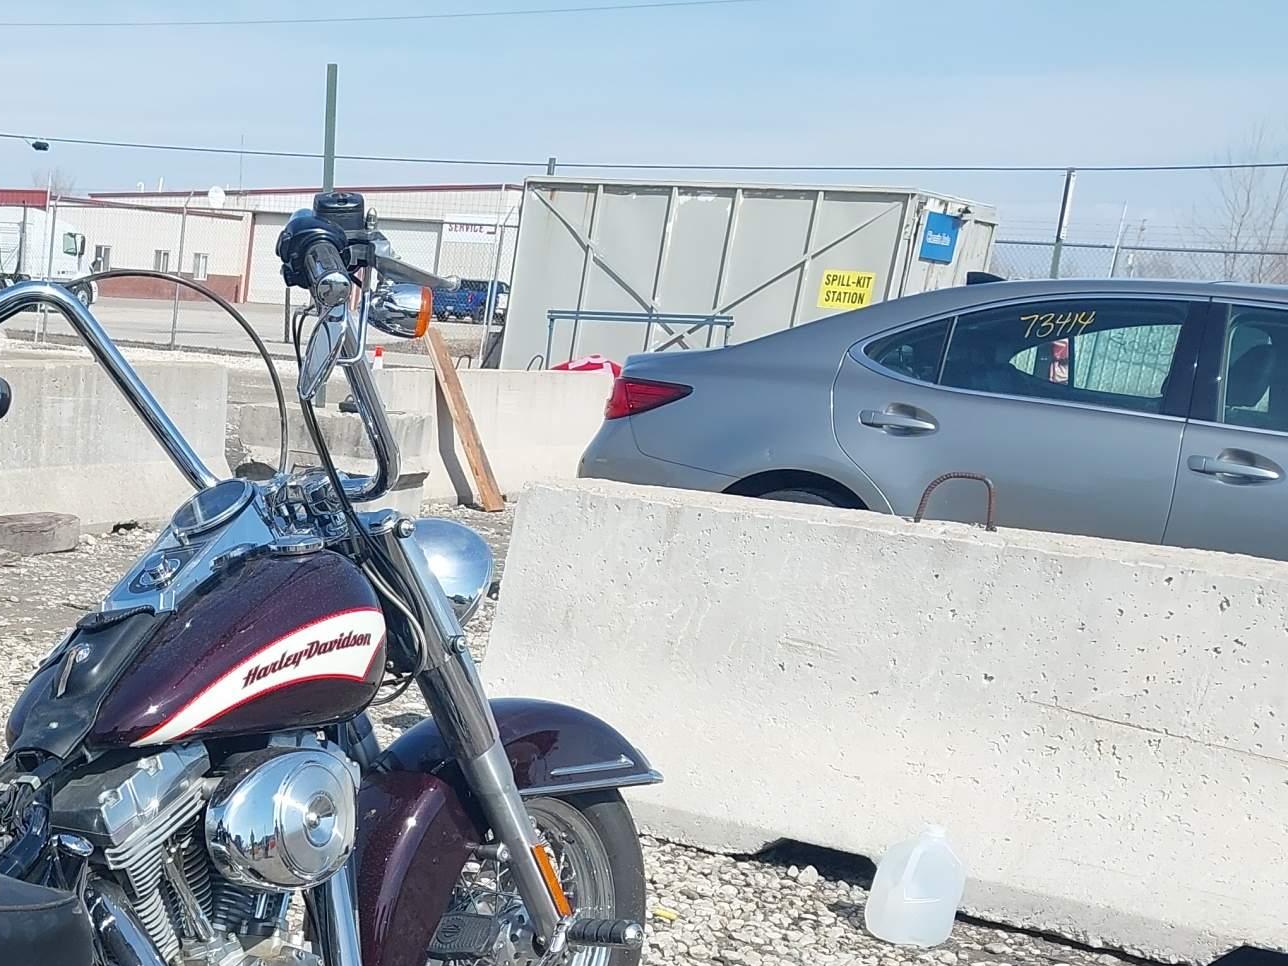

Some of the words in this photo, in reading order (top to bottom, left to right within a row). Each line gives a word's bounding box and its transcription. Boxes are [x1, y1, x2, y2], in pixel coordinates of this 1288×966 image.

[448, 222, 485, 233] SERVICE
[824, 273, 873, 289] SPILL-KIT
[824, 290, 866, 305] STATION
[1020, 311, 1097, 339] 73414
